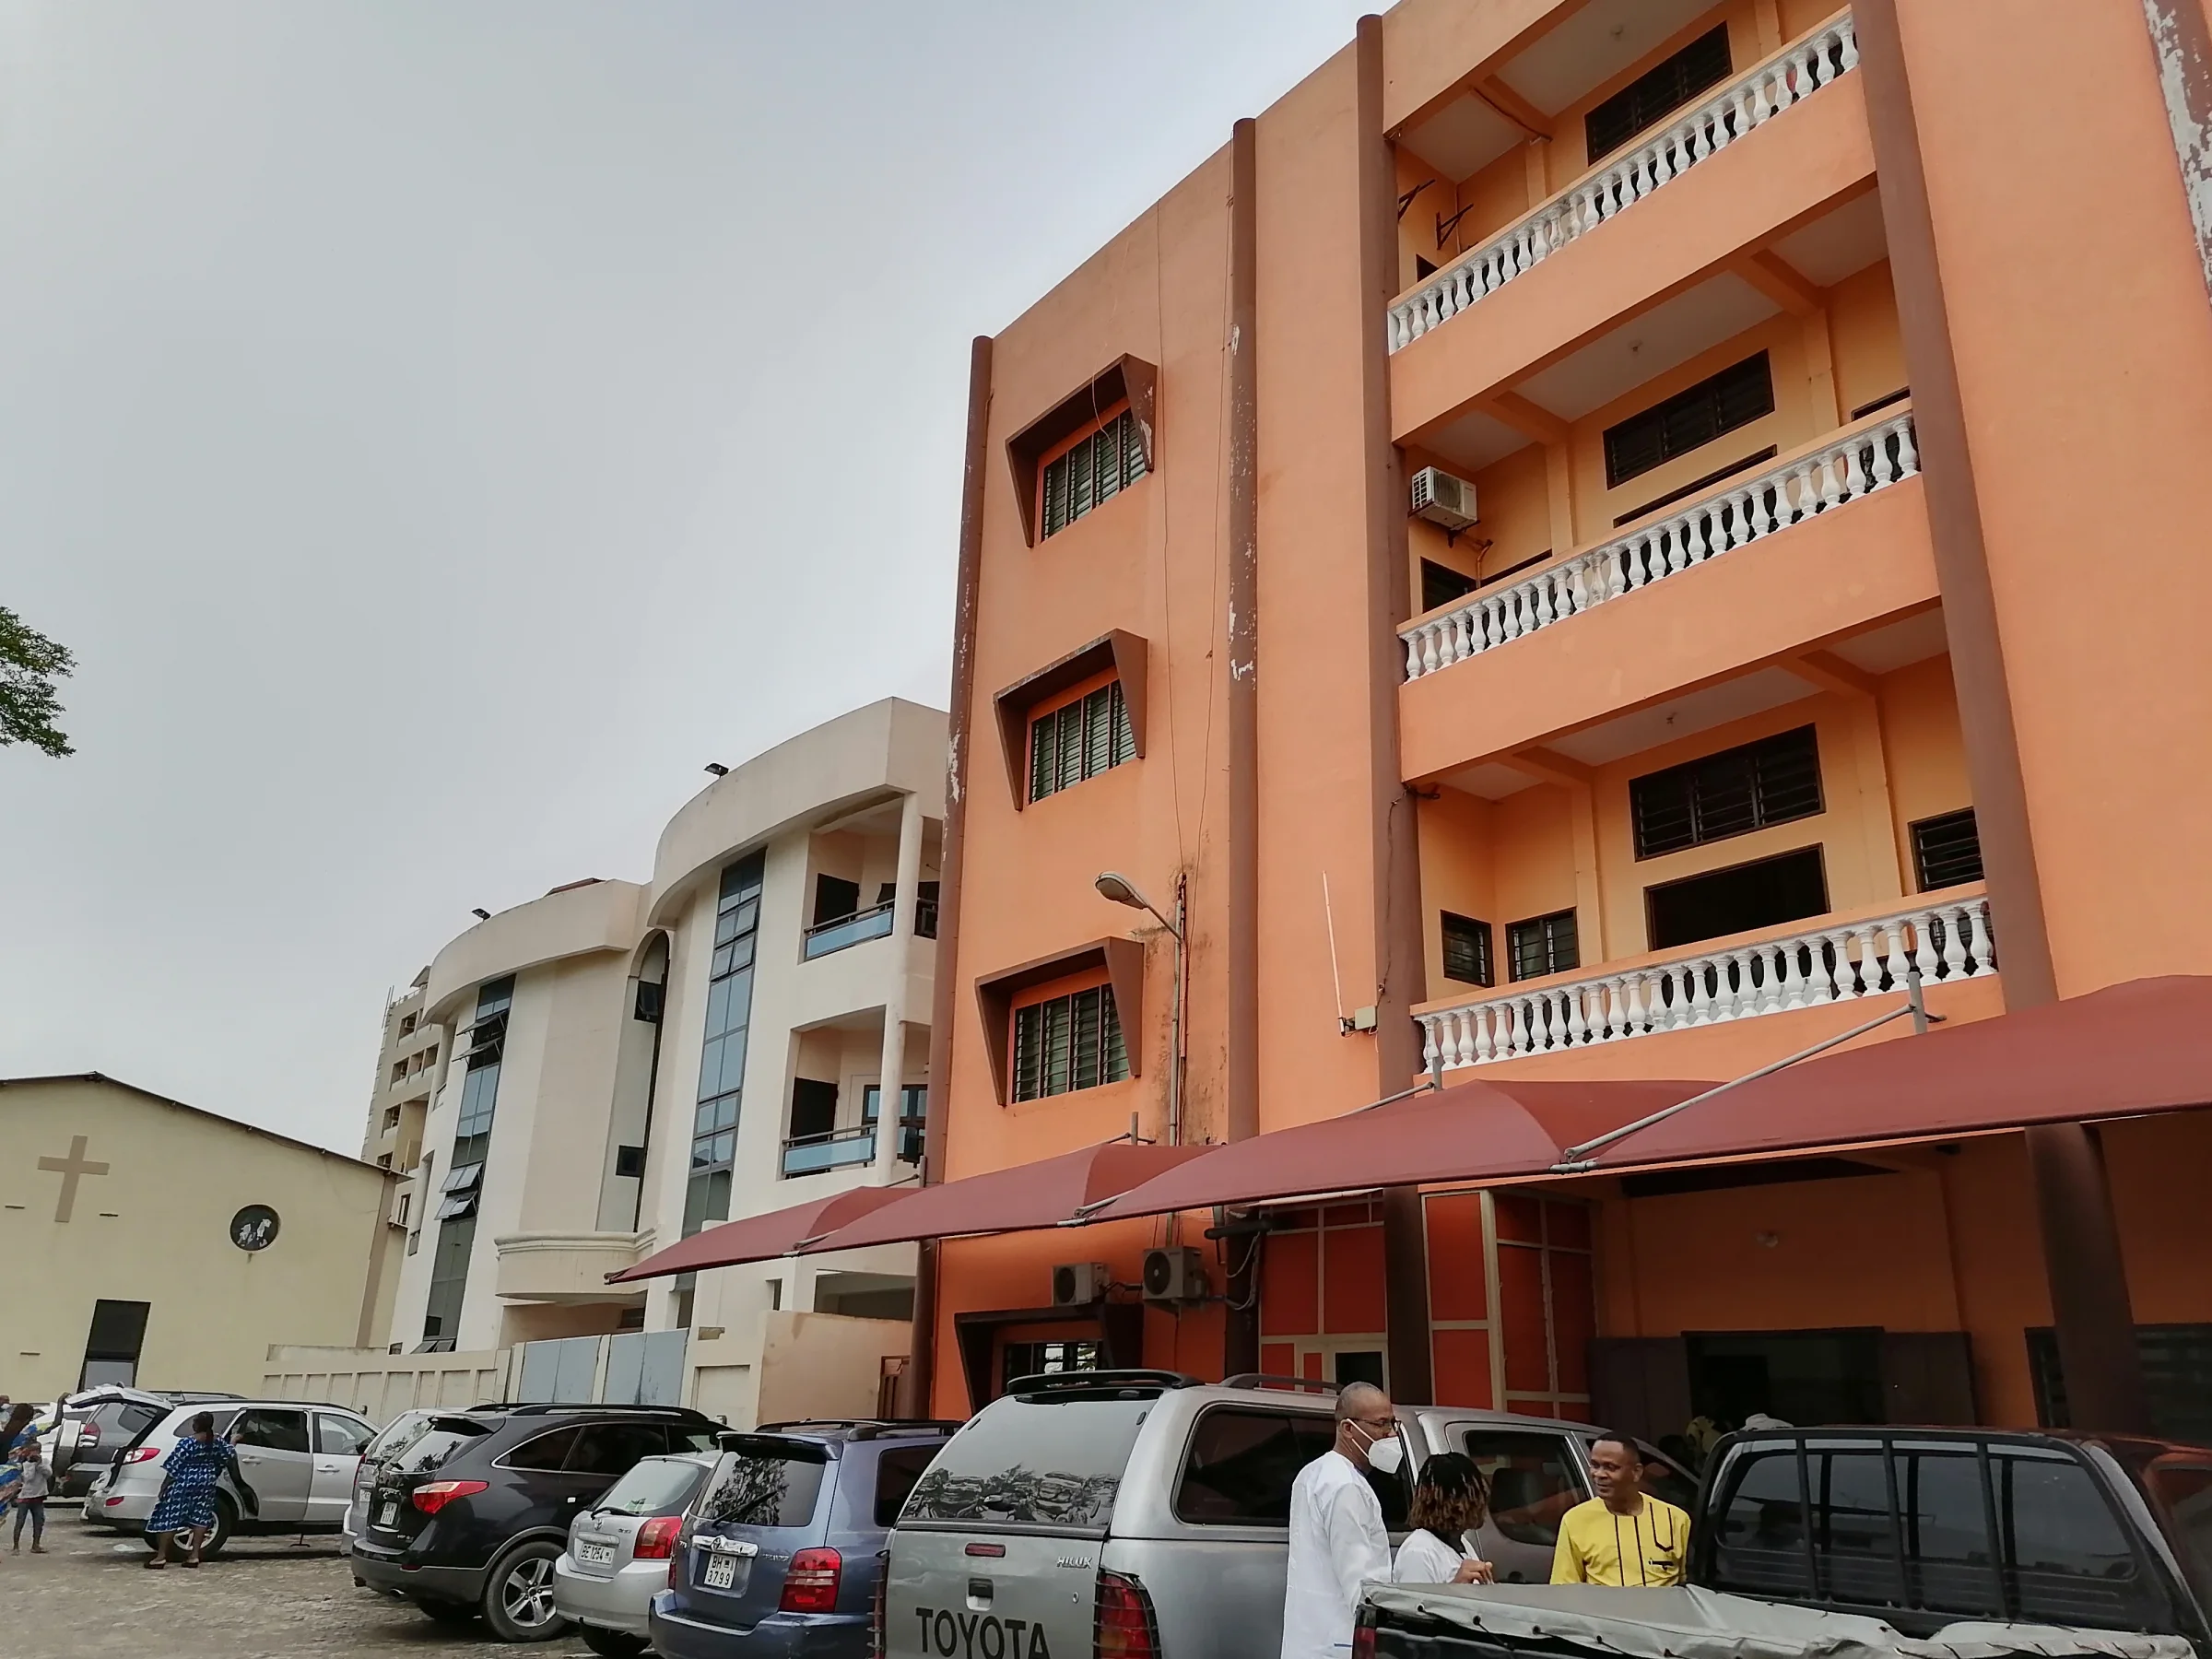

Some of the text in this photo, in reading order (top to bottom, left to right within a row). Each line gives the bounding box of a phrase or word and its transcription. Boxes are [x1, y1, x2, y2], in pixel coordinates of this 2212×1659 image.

[712, 1555, 724, 1570] BH
[1056, 1557, 1092, 1569] HILUX
[708, 1570, 730, 1585] 3799
[915, 1607, 1051, 1659] TOYOTA
